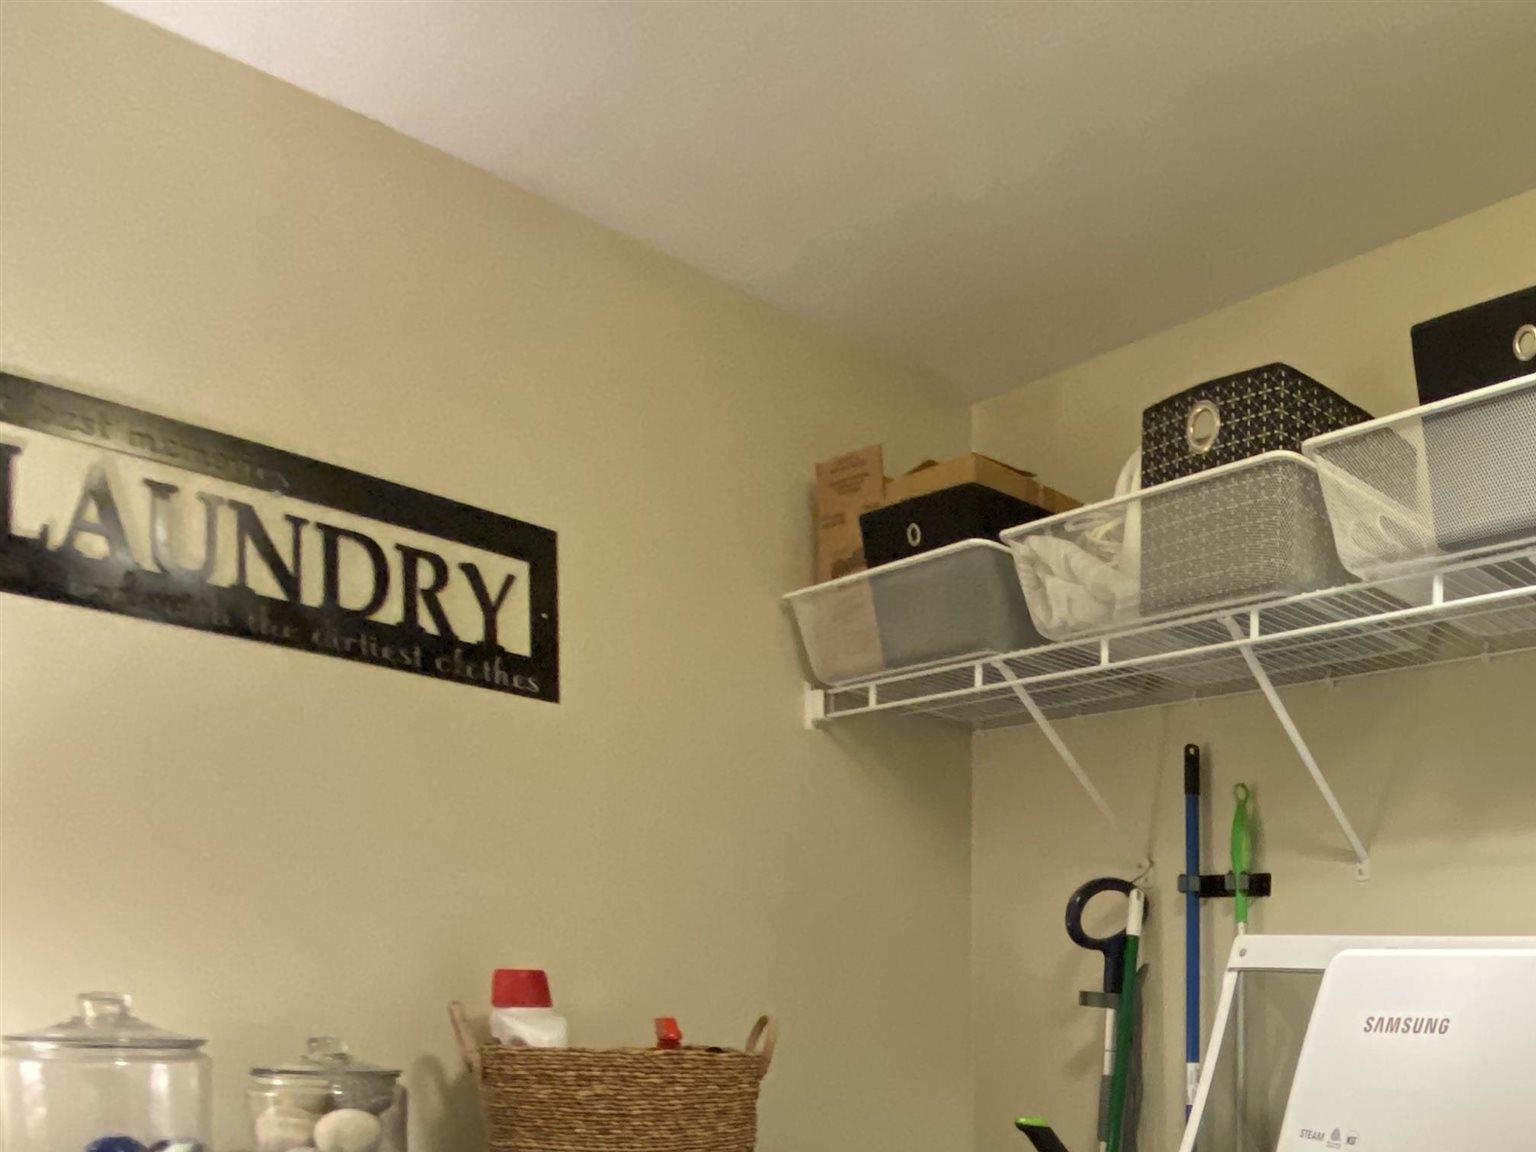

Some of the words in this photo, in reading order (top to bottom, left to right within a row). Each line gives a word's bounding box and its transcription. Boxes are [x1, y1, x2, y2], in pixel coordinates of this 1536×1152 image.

[0, 444, 518, 651] LAUNDRY
[1363, 1016, 1450, 1035] SAMSUNG
[1299, 1128, 1326, 1142] STEAM
